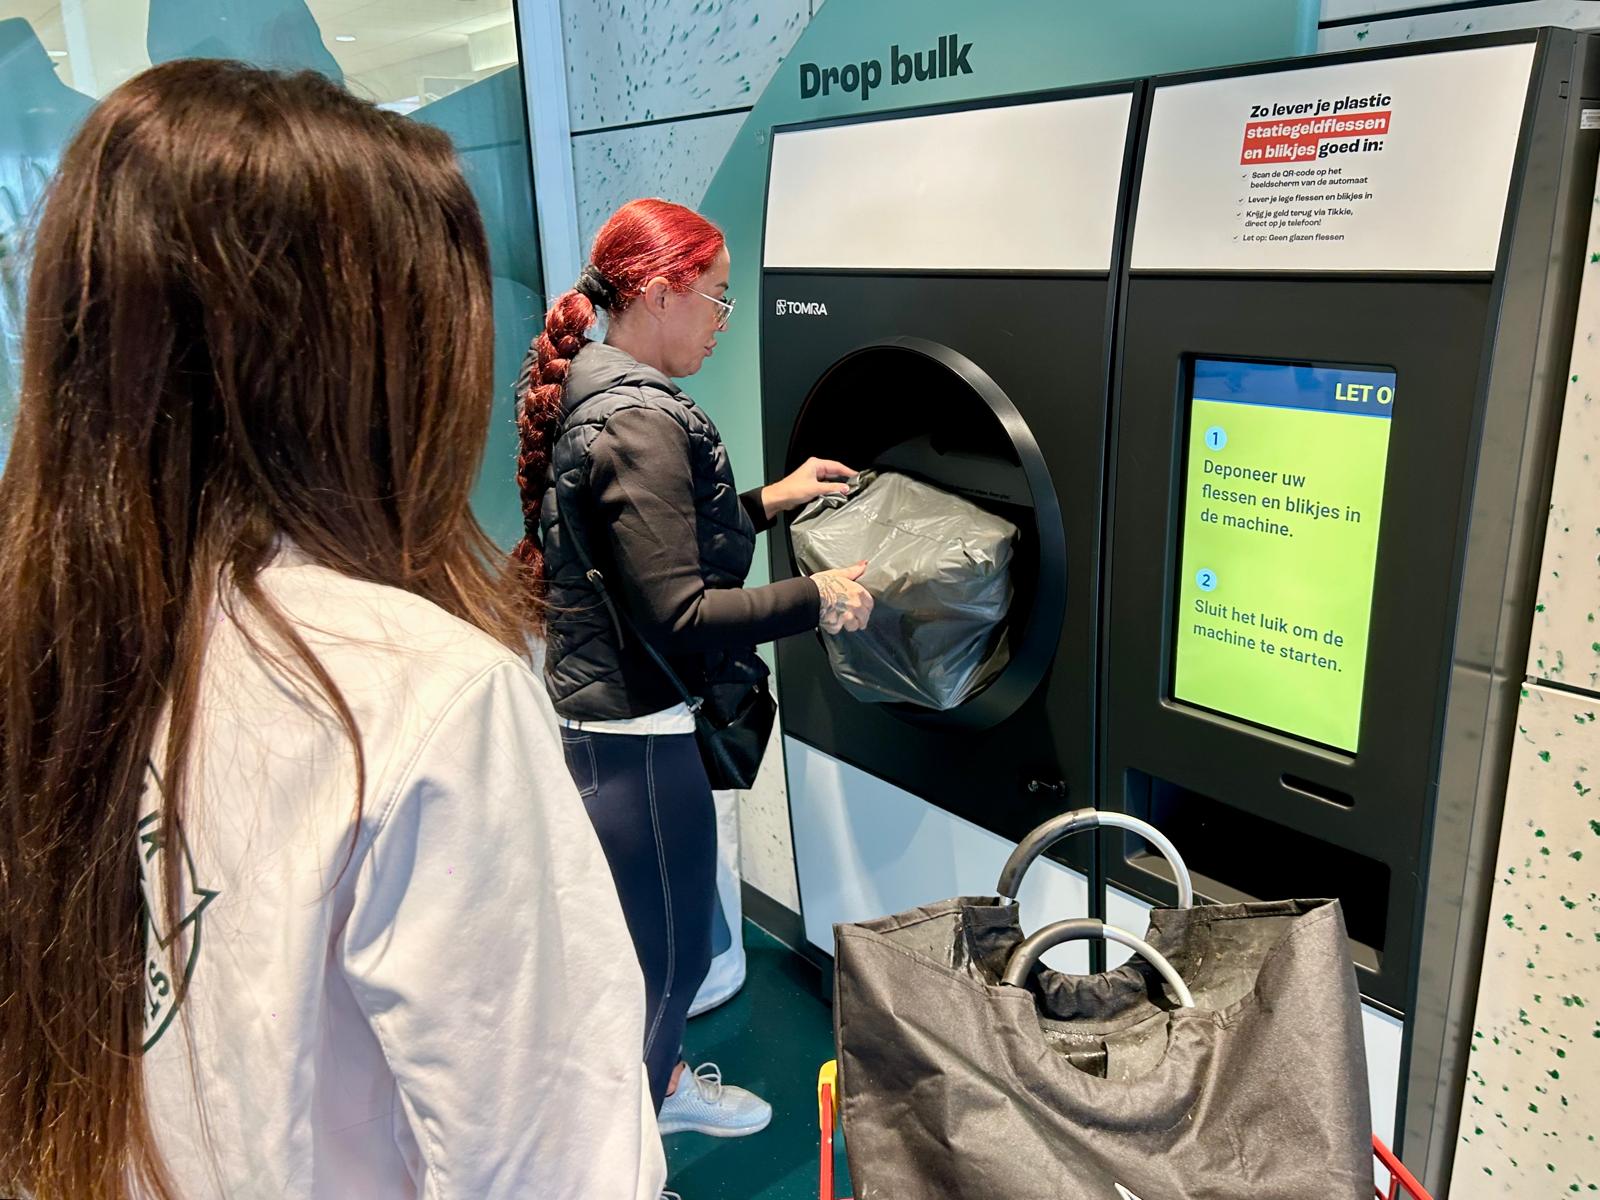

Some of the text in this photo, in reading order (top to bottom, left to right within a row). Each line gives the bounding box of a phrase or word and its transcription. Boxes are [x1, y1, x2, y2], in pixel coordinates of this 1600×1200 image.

[799, 33, 974, 101] Drop bulk
[1250, 93, 1392, 118] Zo lever je plastic
[1246, 117, 1386, 139] statiegeldflessen
[1243, 138, 1384, 161] en blikjes goed in:
[1250, 180, 1300, 188] beeldscherm
[1317, 178, 1327, 186] de
[1328, 177, 1369, 185] automaat
[1252, 167, 1342, 179] Scan de QR-code op het
[1269, 195, 1278, 204] je
[1278, 195, 1294, 203] lege
[1295, 194, 1324, 202] flessen
[1336, 192, 1363, 202] blikjes
[1364, 191, 1373, 200] in
[1245, 218, 1322, 228] direct op je telefoon!
[1246, 207, 1354, 219] Krijg je geld terug via Tikkie,
[1255, 234, 1267, 243] op:
[1288, 233, 1314, 243] glazen
[1315, 233, 1345, 241] flessen
[786, 301, 828, 316] TOMRA
[1335, 382, 1396, 405] LET O
[1212, 431, 1219, 446] 1
[1203, 459, 1306, 488] Deponeer uw
[1202, 483, 1361, 523] flessen en blikjes in
[1200, 508, 1294, 538] de machine.
[1201, 573, 1211, 587] 2
[1194, 599, 1344, 647] Sluit het luik om de
[1193, 623, 1343, 673] machine te starten.
